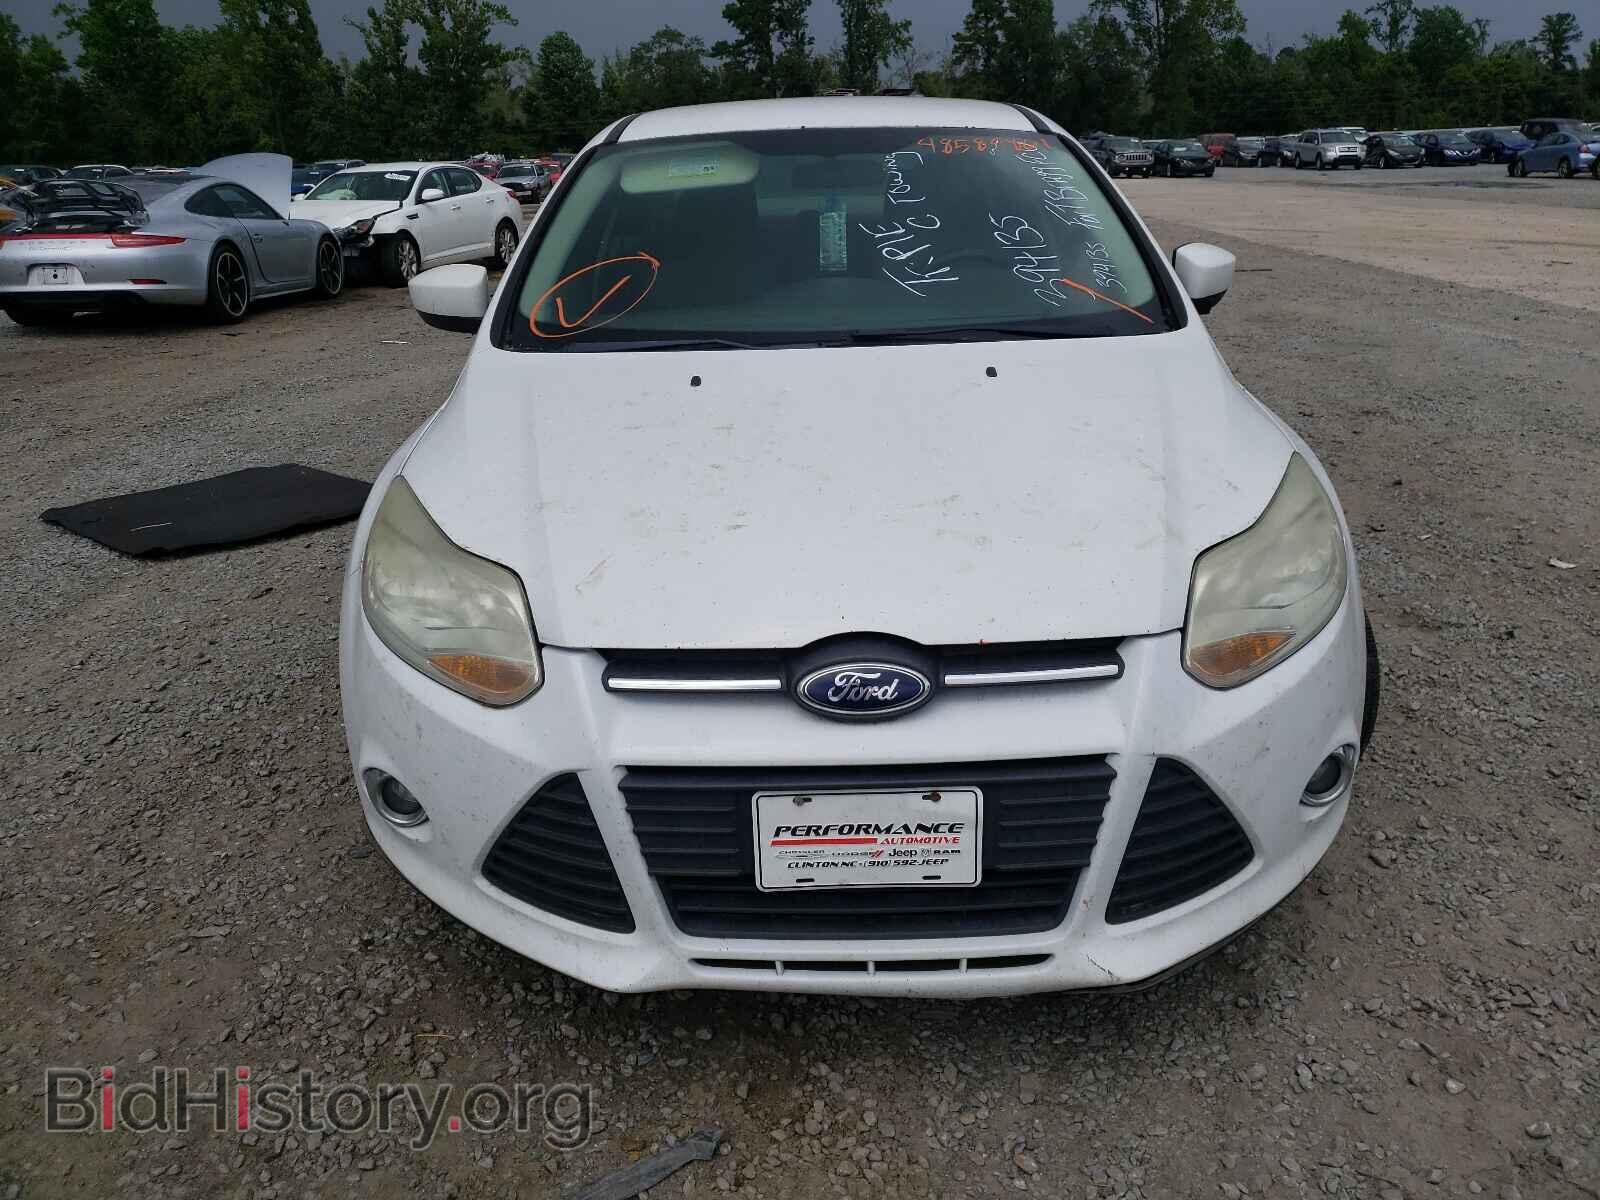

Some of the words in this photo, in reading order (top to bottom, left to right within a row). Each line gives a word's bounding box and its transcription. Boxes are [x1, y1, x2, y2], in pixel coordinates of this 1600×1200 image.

[827, 671, 900, 702] Ford
[773, 822, 965, 838] PERFORMANCE
[880, 836, 961, 846] AUTOMOTIVE
[888, 848, 918, 859] Jeep
[787, 860, 837, 869] CLINTON
[840, 860, 858, 868] NC
[863, 859, 892, 868] (910)
[893, 858, 950, 867] 592-JEEP
